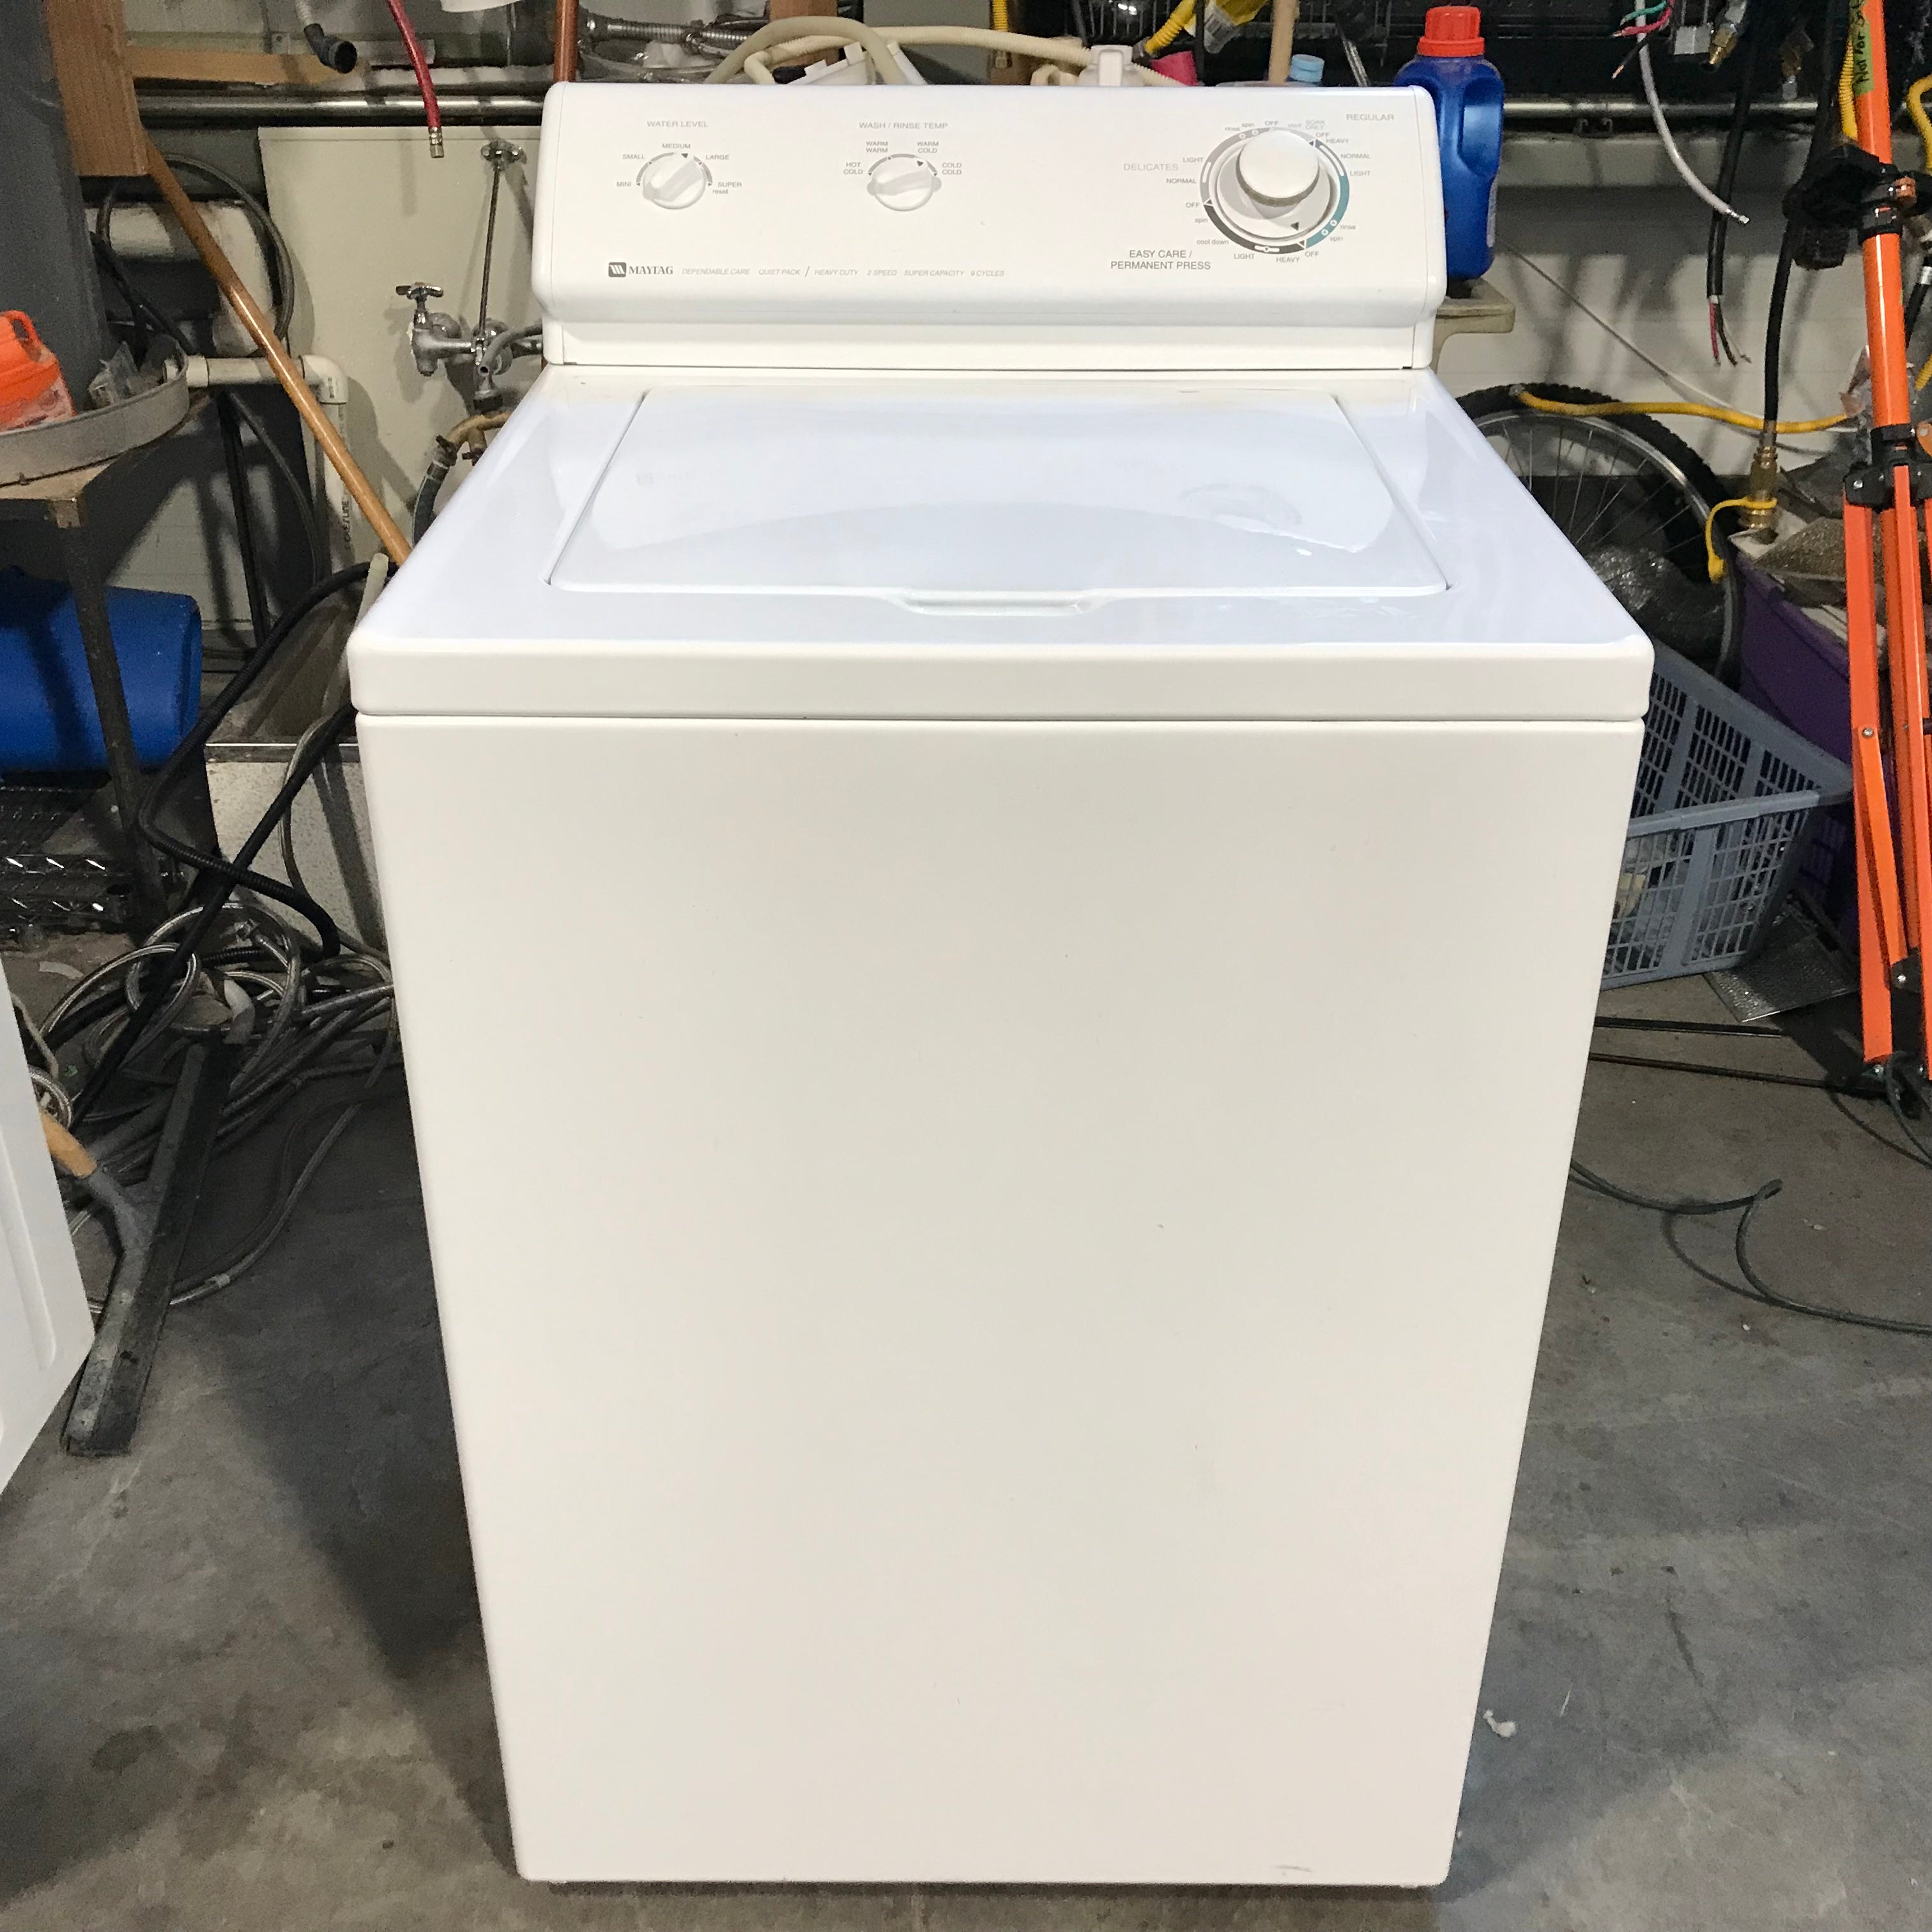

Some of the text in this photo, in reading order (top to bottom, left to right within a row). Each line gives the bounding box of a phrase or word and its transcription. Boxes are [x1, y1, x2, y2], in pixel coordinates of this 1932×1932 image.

[1123, 163, 1179, 172] DELICATES
[1129, 250, 1193, 258] EASY CARE /
[1110, 261, 1211, 270] PERMANENT PRESS
[629, 266, 673, 275] MAYTAG
